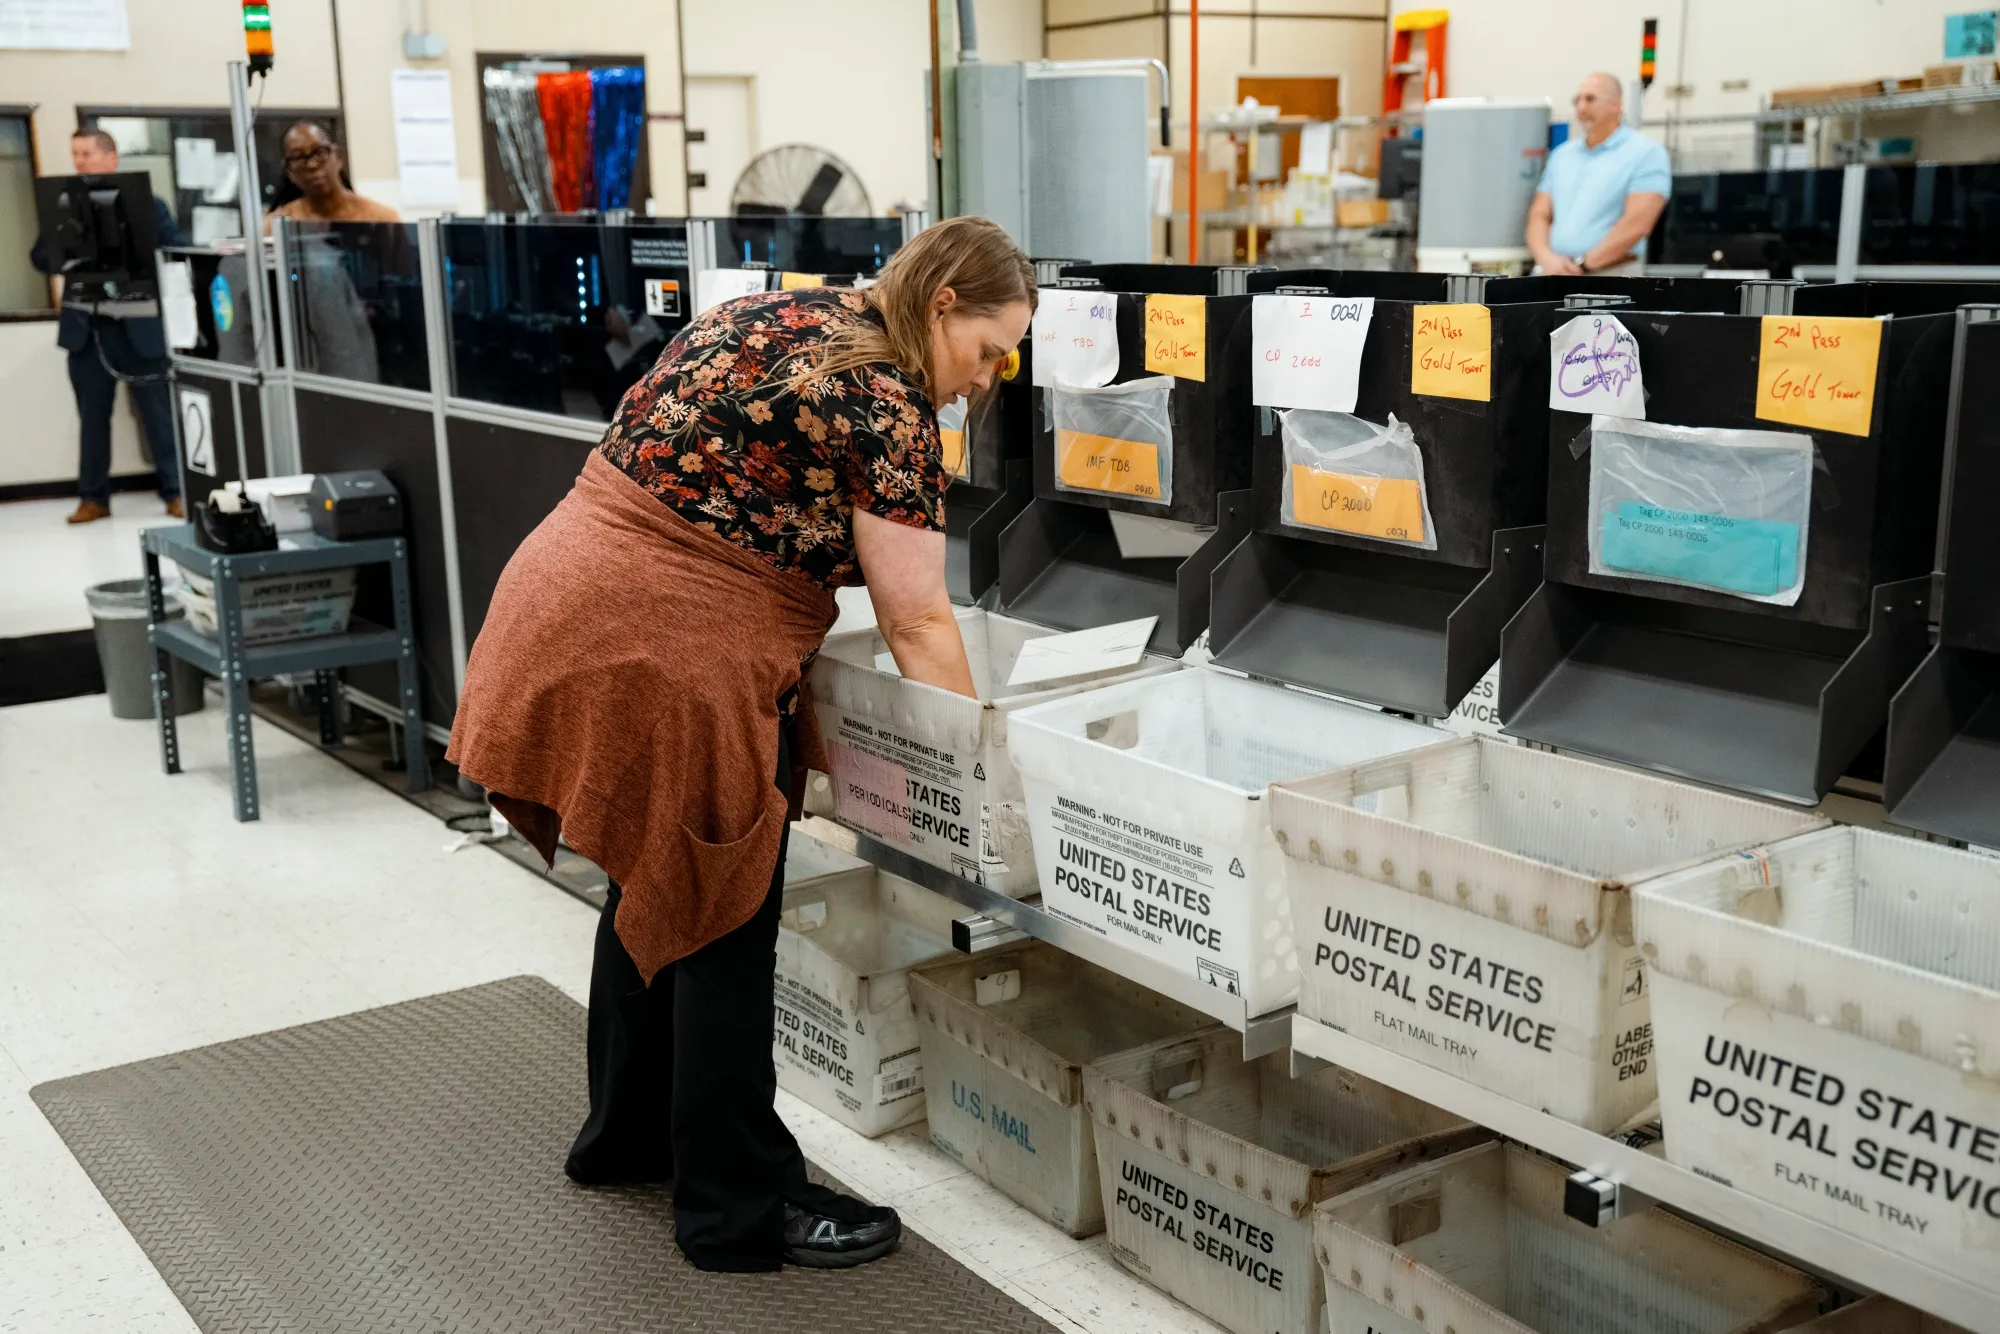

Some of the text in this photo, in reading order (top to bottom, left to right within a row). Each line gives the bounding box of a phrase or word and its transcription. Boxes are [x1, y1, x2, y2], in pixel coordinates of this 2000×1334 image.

[1165, 310, 1185, 326] Pass
[1331, 303, 1363, 322] 0021
[1441, 317, 1463, 340] Pass
[1154, 340, 1178, 361] Gold
[1774, 322, 1841, 350] 2nd Pass
[1420, 347, 1487, 375] Gold Tower
[1771, 369, 1862, 401] Gold Tower
[186, 402, 207, 469] 2
[1086, 455, 1106, 470] IMF
[1134, 484, 1154, 495] 0010
[1321, 489, 1372, 512] CP 2000
[1618, 518, 1709, 543] Tag CP 2000 143-0006
[1638, 506, 1734, 528] Tag CP 2000 143-0006
[1454, 701, 1500, 725] VICE
[843, 716, 873, 736] WARNING
[878, 729, 893, 742] NOT
[894, 735, 908, 748] FOR
[909, 741, 938, 759] PRIVATE
[940, 751, 955, 765] USE
[849, 783, 908, 820] PERIODICALS
[908, 806, 970, 848] ERVICE
[1051, 810, 1075, 825] MAXIMUM
[1075, 820, 1096, 833] PENALTY
[1096, 827, 1107, 837] FOR
[1107, 831, 1123, 843] THEFT
[1132, 840, 1152, 854] MISUSE
[1161, 851, 1182, 865] POSTAL
[1182, 859, 1213, 876] PROPERTY
[1057, 795, 1096, 819] WARNING
[1103, 813, 1121, 829] NOT
[1123, 820, 1142, 837] FOR
[1143, 827, 1181, 850] PRIVATE
[1184, 841, 1204, 858] USE
[1079, 830, 1090, 839] FINE
[1090, 833, 1100, 843] AND
[1105, 839, 1122, 851] YEARS
[1122, 846, 1161, 867] IMPRISONMENT
[1171, 864, 1182, 874] USC
[1060, 839, 1211, 916] UNITED STATES
[1055, 866, 1222, 952] POSTAL SERVICE
[1106, 914, 1162, 945] FOR MAIL ONLY
[1324, 906, 1544, 1004] UNITED STATES
[788, 978, 800, 990] NOT
[801, 984, 812, 997] FOR
[812, 991, 832, 1011] PRIVATE
[1315, 942, 1556, 1054] POSTAL SERVICE
[774, 1005, 800, 1031] TED
[802, 1021, 848, 1061] STATES
[1374, 1010, 1478, 1061] FLAT MAIL TRAY
[1615, 1022, 1653, 1049] LABE
[773, 1028, 799, 1056] TAL
[802, 1044, 854, 1088] SERVICE
[1618, 1059, 1648, 1082] END
[951, 1079, 985, 1123] U.S.
[991, 1103, 1036, 1154] MAIL
[1704, 1035, 2000, 1164] UNITED STATE
[1689, 1077, 2000, 1220] POSTAL SERVIC
[1122, 1159, 1275, 1254] UNITED STATES
[1774, 1162, 1929, 1235] FLAT MAIL TRAY
[1116, 1187, 1188, 1243] POSTAL
[1193, 1230, 1284, 1292] SERVICE
